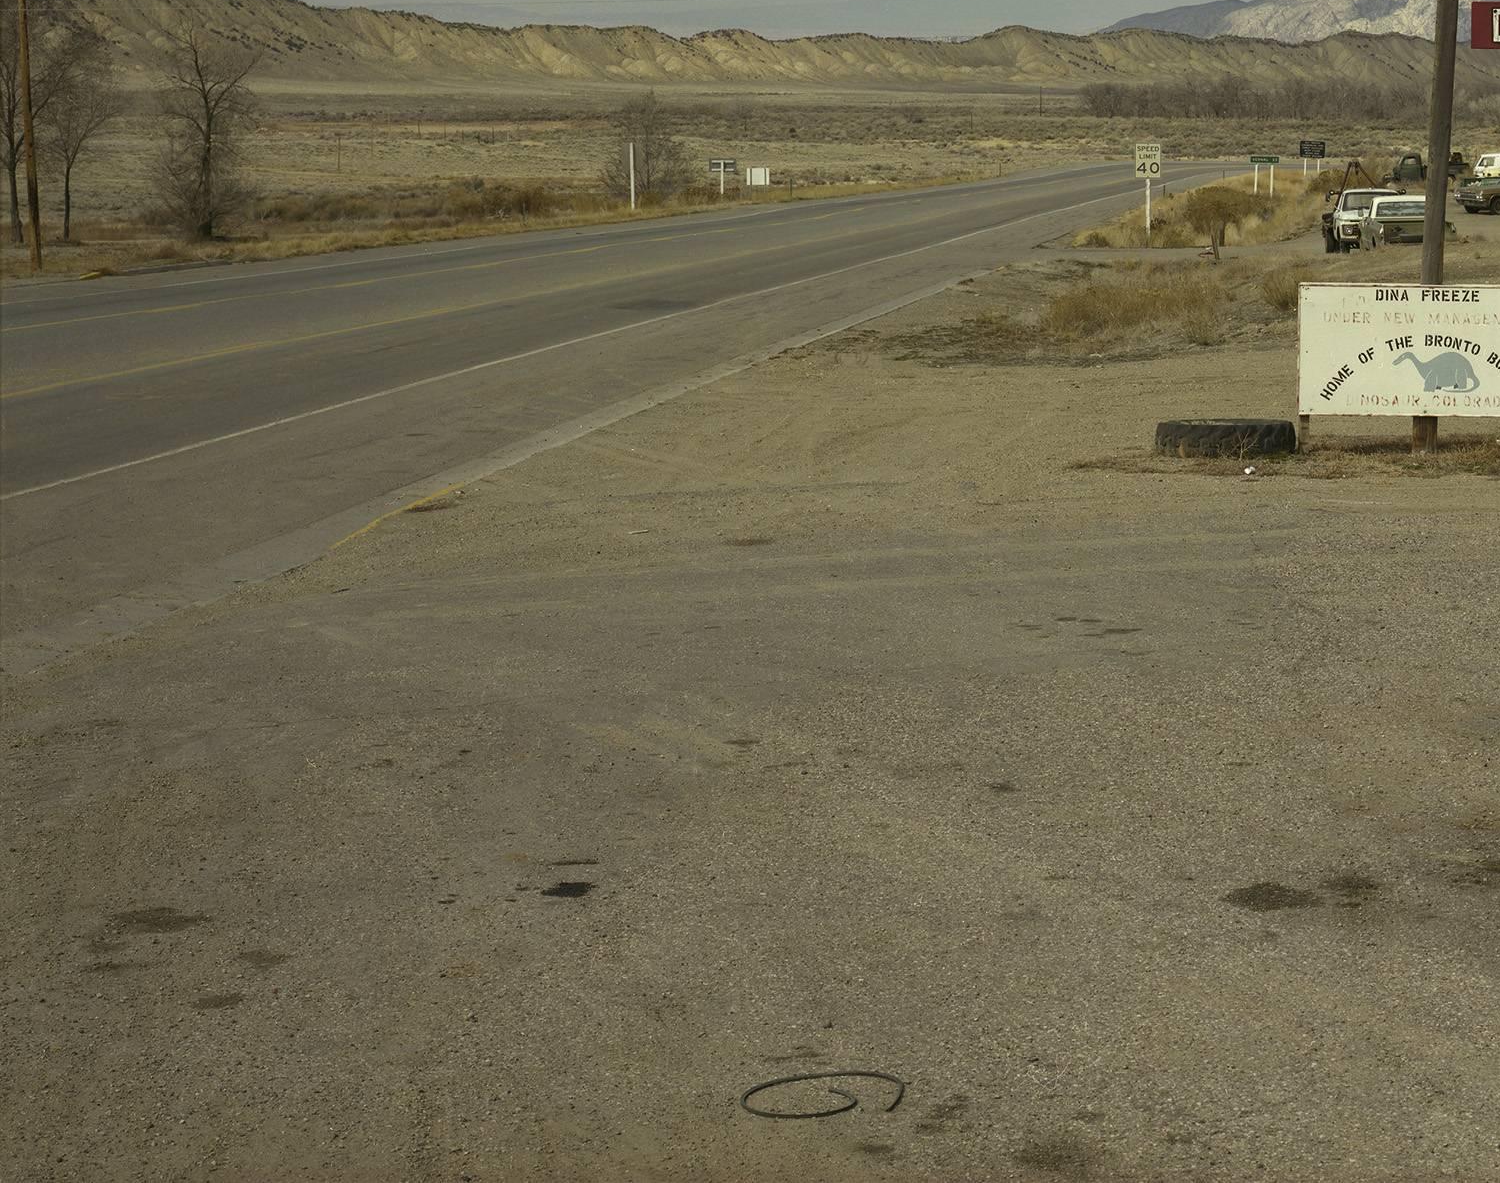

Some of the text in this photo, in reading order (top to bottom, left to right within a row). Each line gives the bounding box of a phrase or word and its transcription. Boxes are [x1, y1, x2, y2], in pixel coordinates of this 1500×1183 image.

[1136, 161, 1160, 174] 40
[1375, 289, 1409, 302] DINA
[1421, 289, 1480, 302] FREEZE
[1322, 311, 1371, 324] UNDER
[1383, 311, 1416, 324] NEW
[1320, 364, 1354, 401] HOME
[1358, 347, 1376, 365] OF
[1385, 335, 1414, 352] THE
[1424, 334, 1481, 356] BRONTO
[1345, 393, 1428, 408] DNOSAUR,
